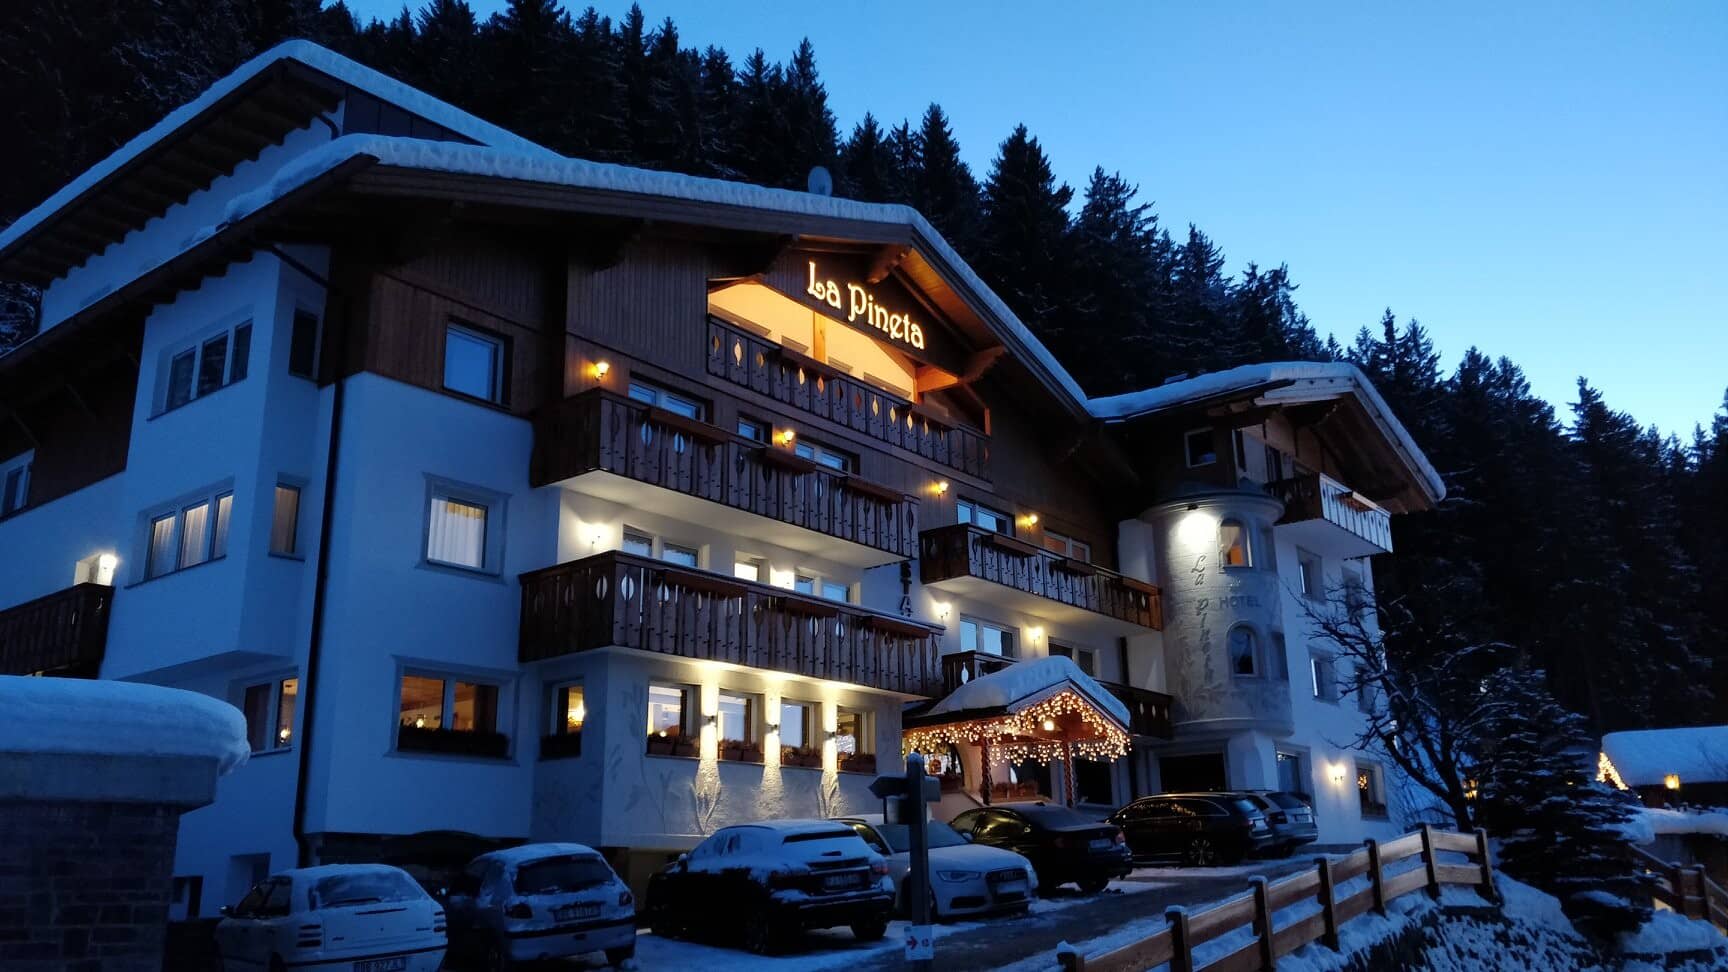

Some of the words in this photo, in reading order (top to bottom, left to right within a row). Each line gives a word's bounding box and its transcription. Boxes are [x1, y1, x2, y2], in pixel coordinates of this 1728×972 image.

[807, 260, 842, 310] La
[847, 281, 925, 350] Pineta
[1218, 595, 1262, 609] HOTEL
